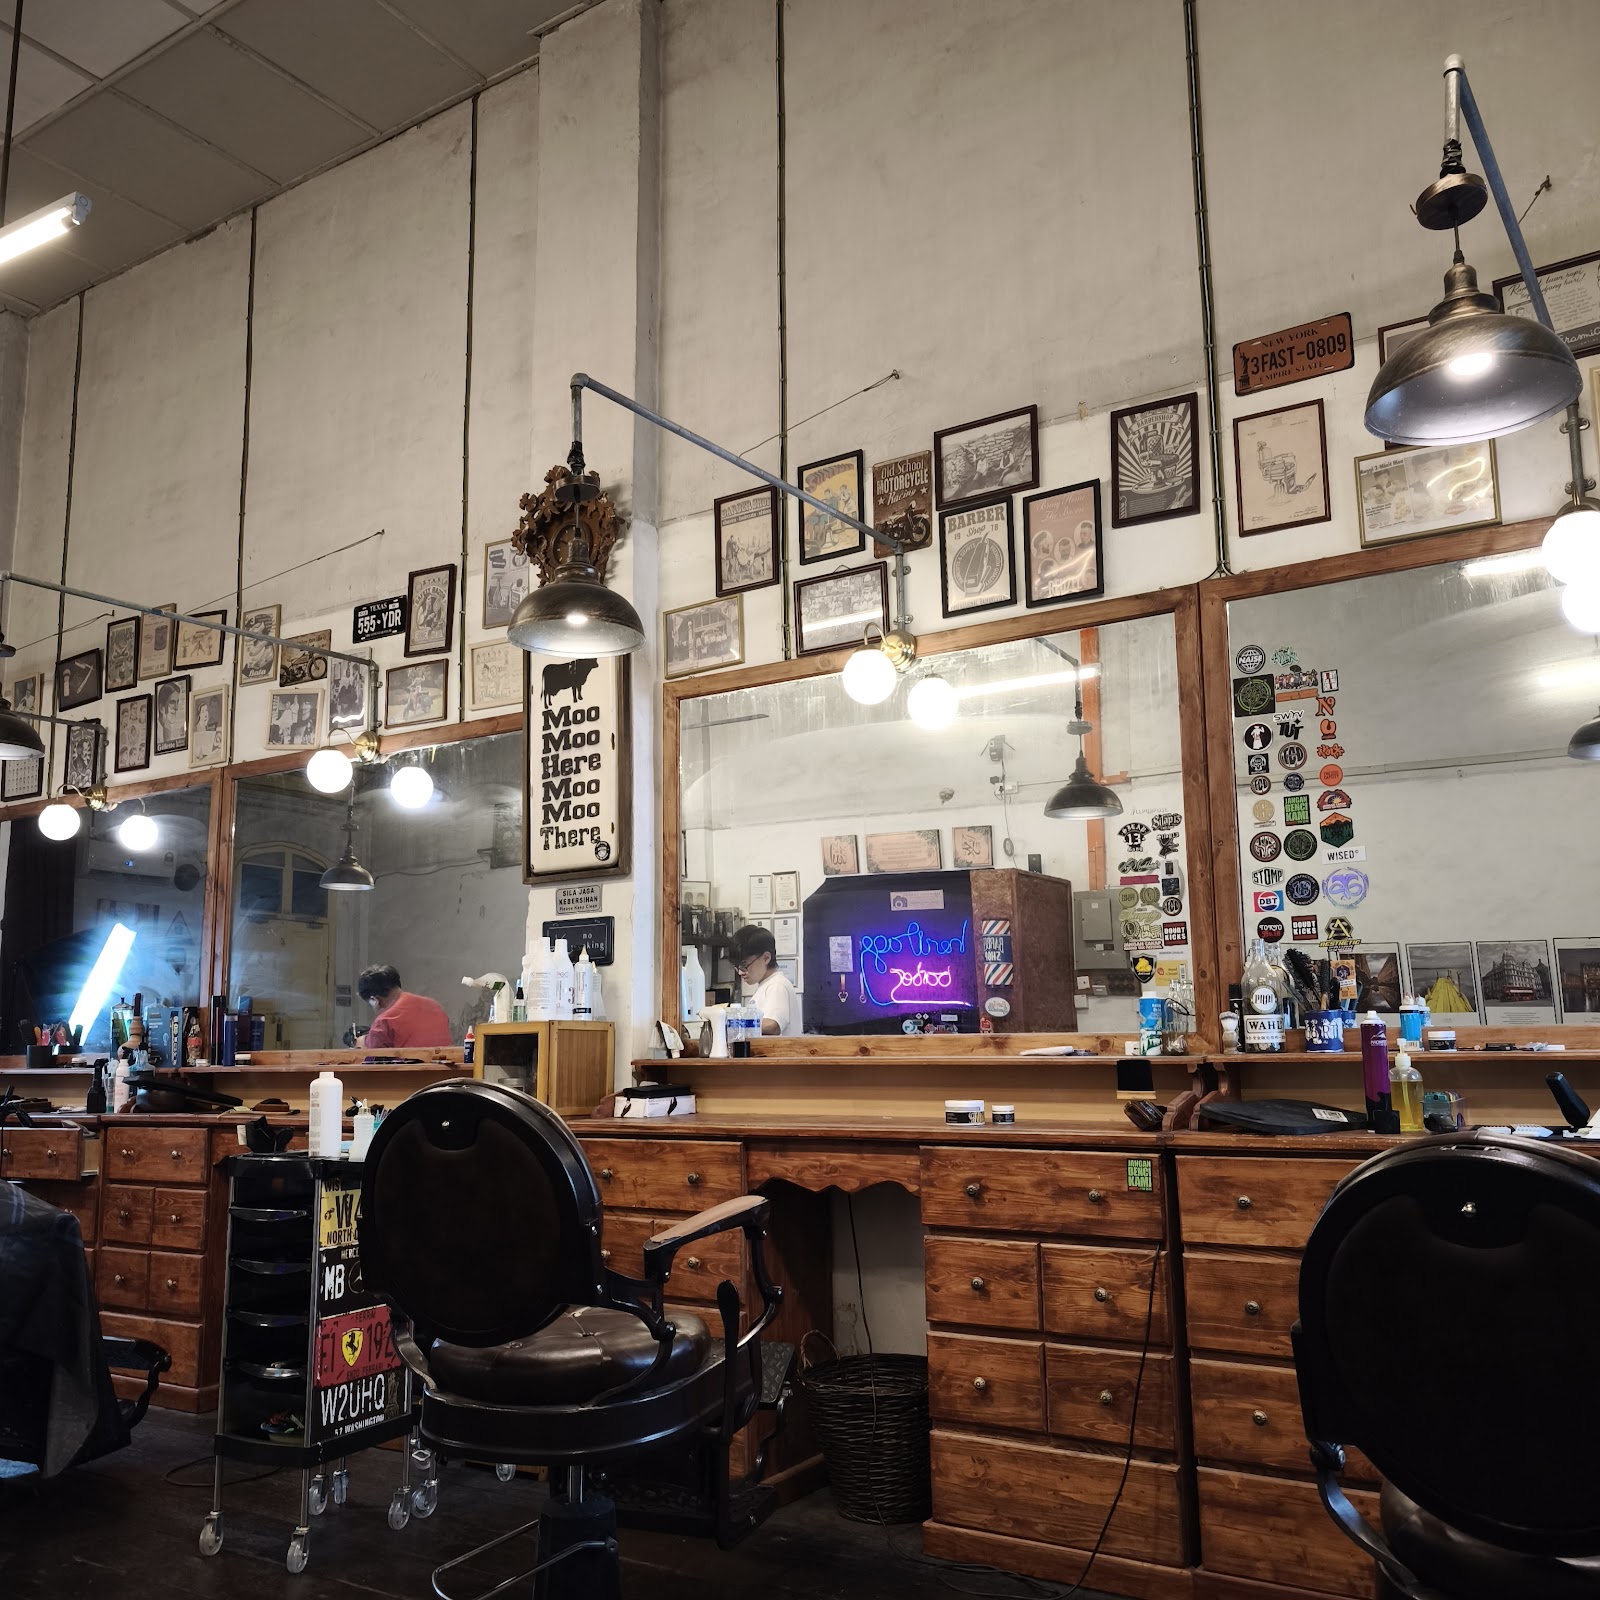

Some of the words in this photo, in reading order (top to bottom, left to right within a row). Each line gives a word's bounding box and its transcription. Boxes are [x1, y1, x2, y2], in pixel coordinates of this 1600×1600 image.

[1262, 338, 1285, 348] NEW
[1288, 328, 1319, 341] YORK
[1251, 333, 1346, 375] 3FAST-0809
[1260, 368, 1292, 382] EMPIRE
[1295, 361, 1324, 373] STATE
[1136, 414, 1174, 428] BARBERSHOP
[881, 463, 895, 479] Old
[897, 459, 924, 474] School
[877, 468, 928, 495] MOTORCYCLE
[887, 489, 917, 505] Racing
[948, 505, 1005, 534] BARBER
[967, 524, 986, 537] Shop
[370, 602, 387, 612] TEXAS
[542, 705, 600, 731] Moo
[157, 742, 176, 752] Gillette
[542, 729, 600, 754] Moo
[541, 753, 601, 779] Here
[542, 777, 600, 802] Moo
[1285, 796, 1308, 805] JANGAN
[1285, 803, 1309, 812] BENCI
[542, 800, 600, 825] Moo
[1286, 811, 1309, 822] KAMI
[540, 826, 601, 850] There
[1127, 833, 1141, 845] 13
[1253, 868, 1282, 885] STOMP
[559, 895, 598, 905] KEBERSIHAN
[562, 889, 577, 897] SILA
[579, 887, 594, 896] JAGA
[1260, 897, 1278, 905] DBT
[1249, 1020, 1282, 1030] WAHL
[1128, 1160, 1151, 1168] JANGAN
[1128, 1167, 1151, 1177] BENCI
[1128, 1176, 1151, 1187] KAMI
[326, 1228, 352, 1245] NORTH
[325, 1264, 345, 1300] MB
[366, 1321, 394, 1362] 192
[346, 1369, 359, 1380] ENZO
[362, 1364, 384, 1376] FERRARI
[344, 1414, 385, 1434] WASHINGTON
